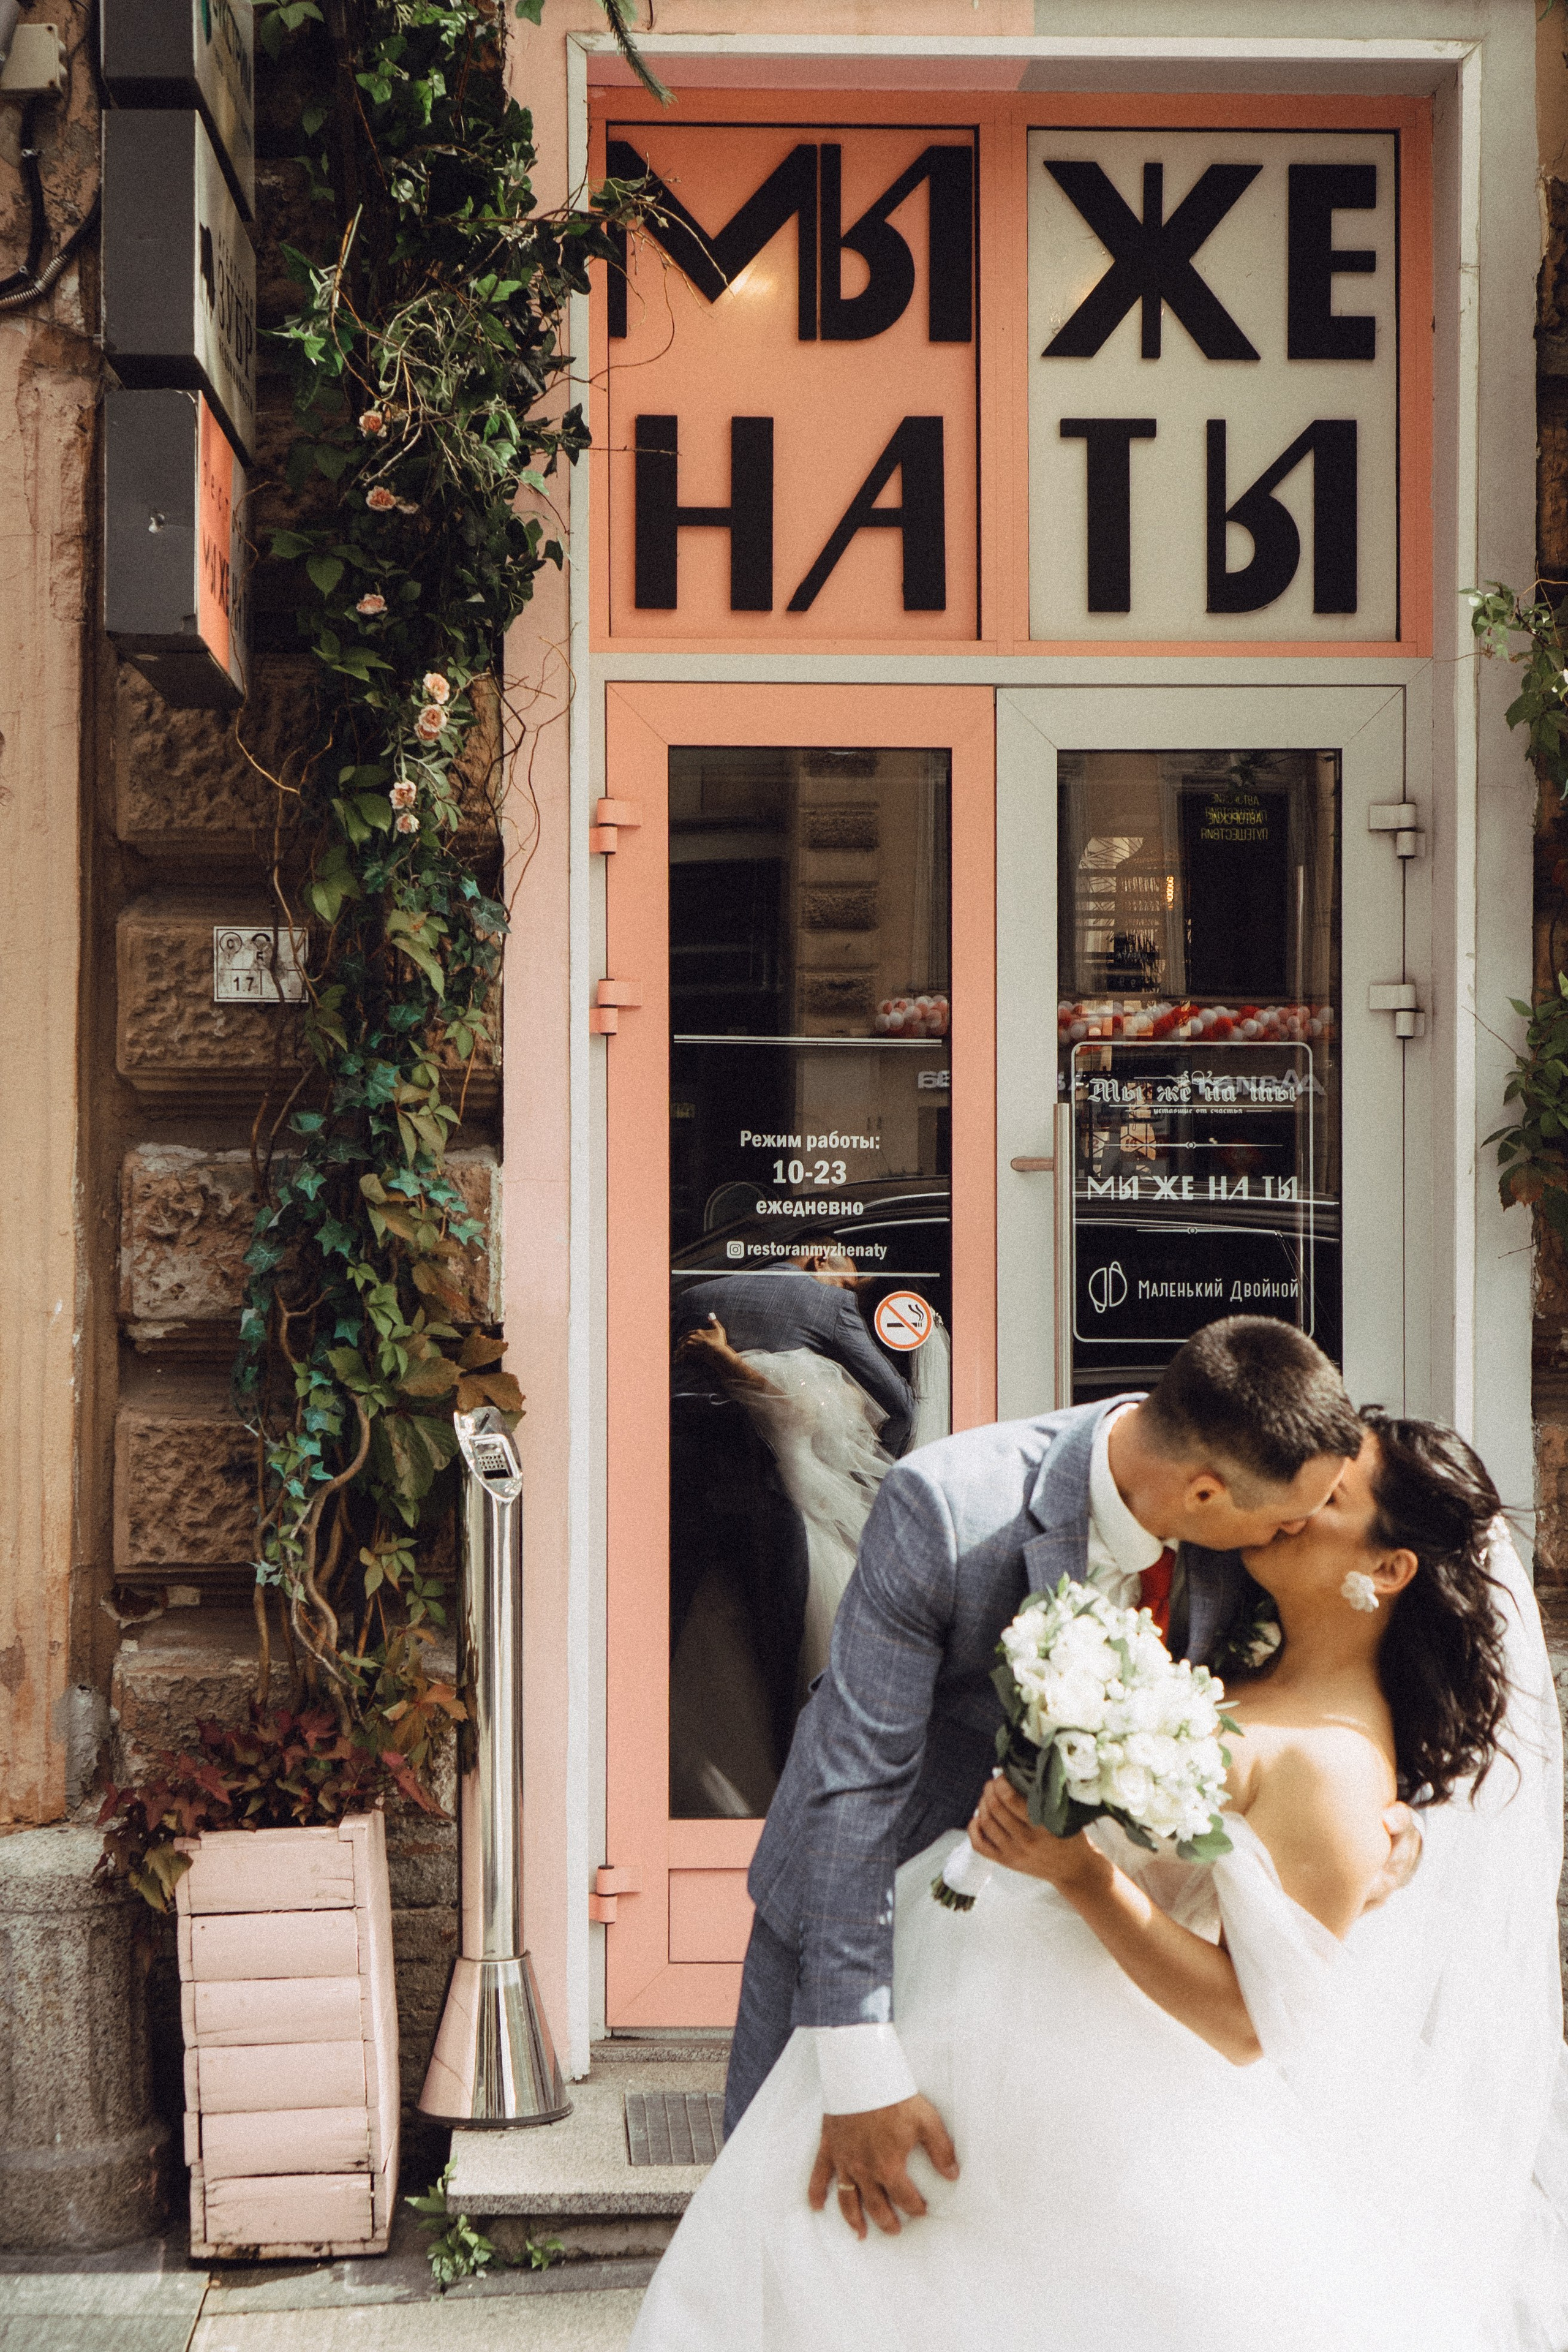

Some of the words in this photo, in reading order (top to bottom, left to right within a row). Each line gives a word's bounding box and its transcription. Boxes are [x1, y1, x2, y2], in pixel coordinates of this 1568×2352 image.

[606, 140, 973, 343] МЫ
[1041, 160, 1377, 361] ЖЕ
[217, 257, 252, 380] ЗУБР
[635, 414, 946, 612] НА
[1059, 417, 1358, 615] ТЫ
[740, 1130, 801, 1147] Режим
[806, 1130, 880, 1152] работы:
[773, 1159, 847, 1185] 10-23
[1087, 1175, 1139, 1200] МЫ
[1152, 1175, 1194, 1200] ЖЕ
[1208, 1175, 1249, 1200] НА
[1262, 1175, 1298, 1200] ТЫ
[756, 1200, 864, 1217] ежедневно
[747, 1242, 888, 1261] restoranmyzhenaty
